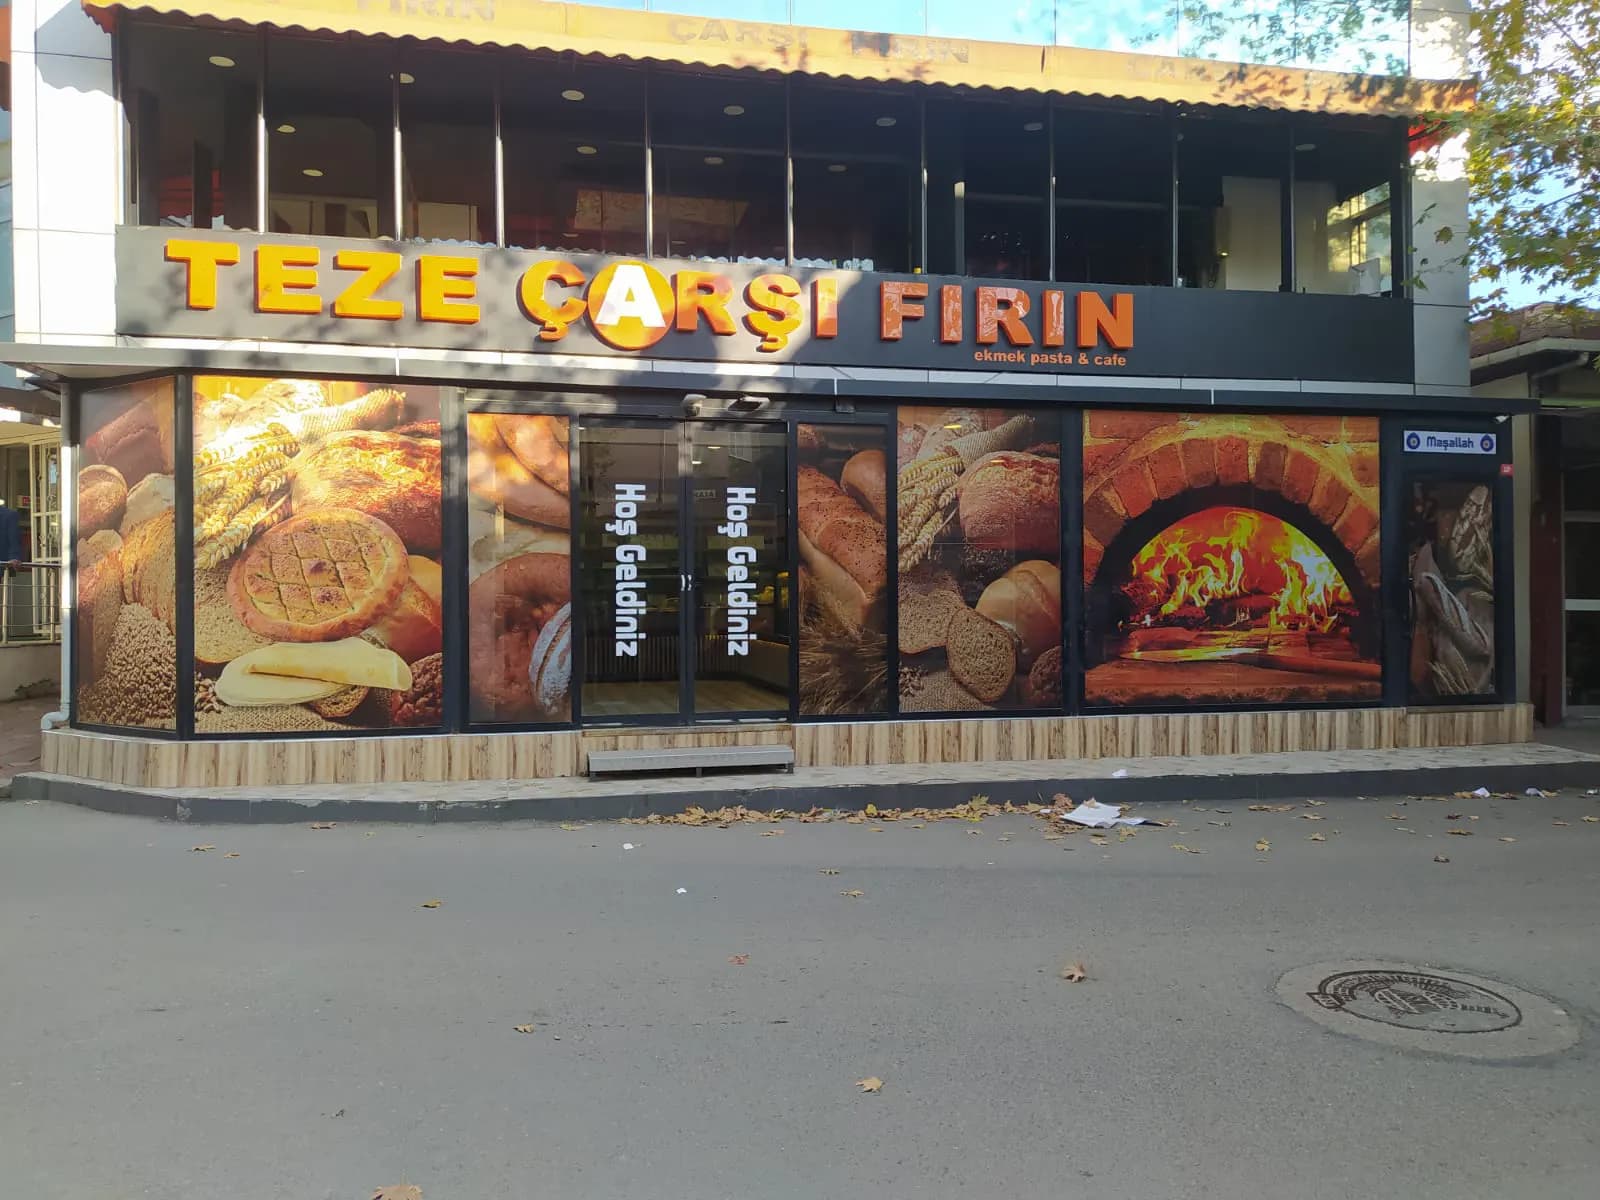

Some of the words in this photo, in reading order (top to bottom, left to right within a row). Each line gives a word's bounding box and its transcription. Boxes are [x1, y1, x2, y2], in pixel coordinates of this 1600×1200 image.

[164, 239, 480, 325] TEZE
[517, 260, 839, 353] ÇARŞI
[879, 280, 1134, 350] FIRIN
[974, 349, 1026, 363] ekmek
[1030, 350, 1073, 366] pasta
[1078, 352, 1089, 365] &
[1094, 353, 1127, 366] cafe
[1426, 435, 1474, 451] Maşallah
[605, 484, 646, 536] Hoş
[717, 487, 756, 538] Hoş
[615, 544, 647, 657] Geldiniz
[727, 546, 757, 656] Geldiniz
